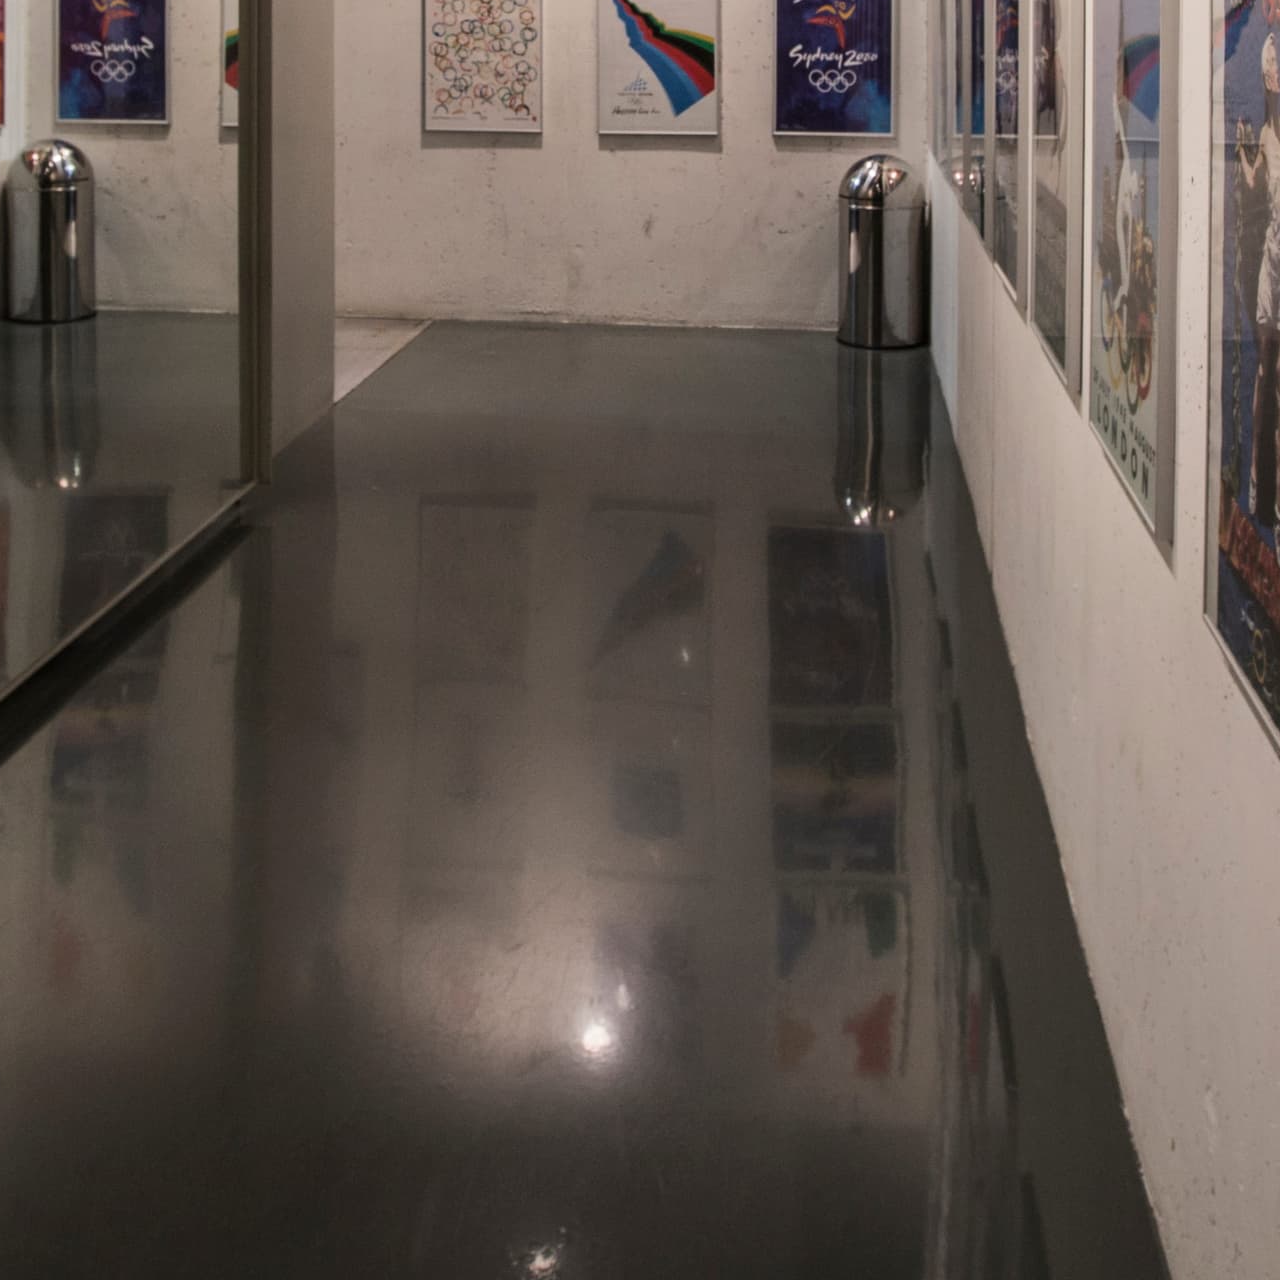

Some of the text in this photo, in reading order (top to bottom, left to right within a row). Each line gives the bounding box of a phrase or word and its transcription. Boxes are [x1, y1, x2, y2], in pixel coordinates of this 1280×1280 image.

[788, 43, 879, 70] Sydney 2000
[1097, 393, 1149, 500] LONDON
